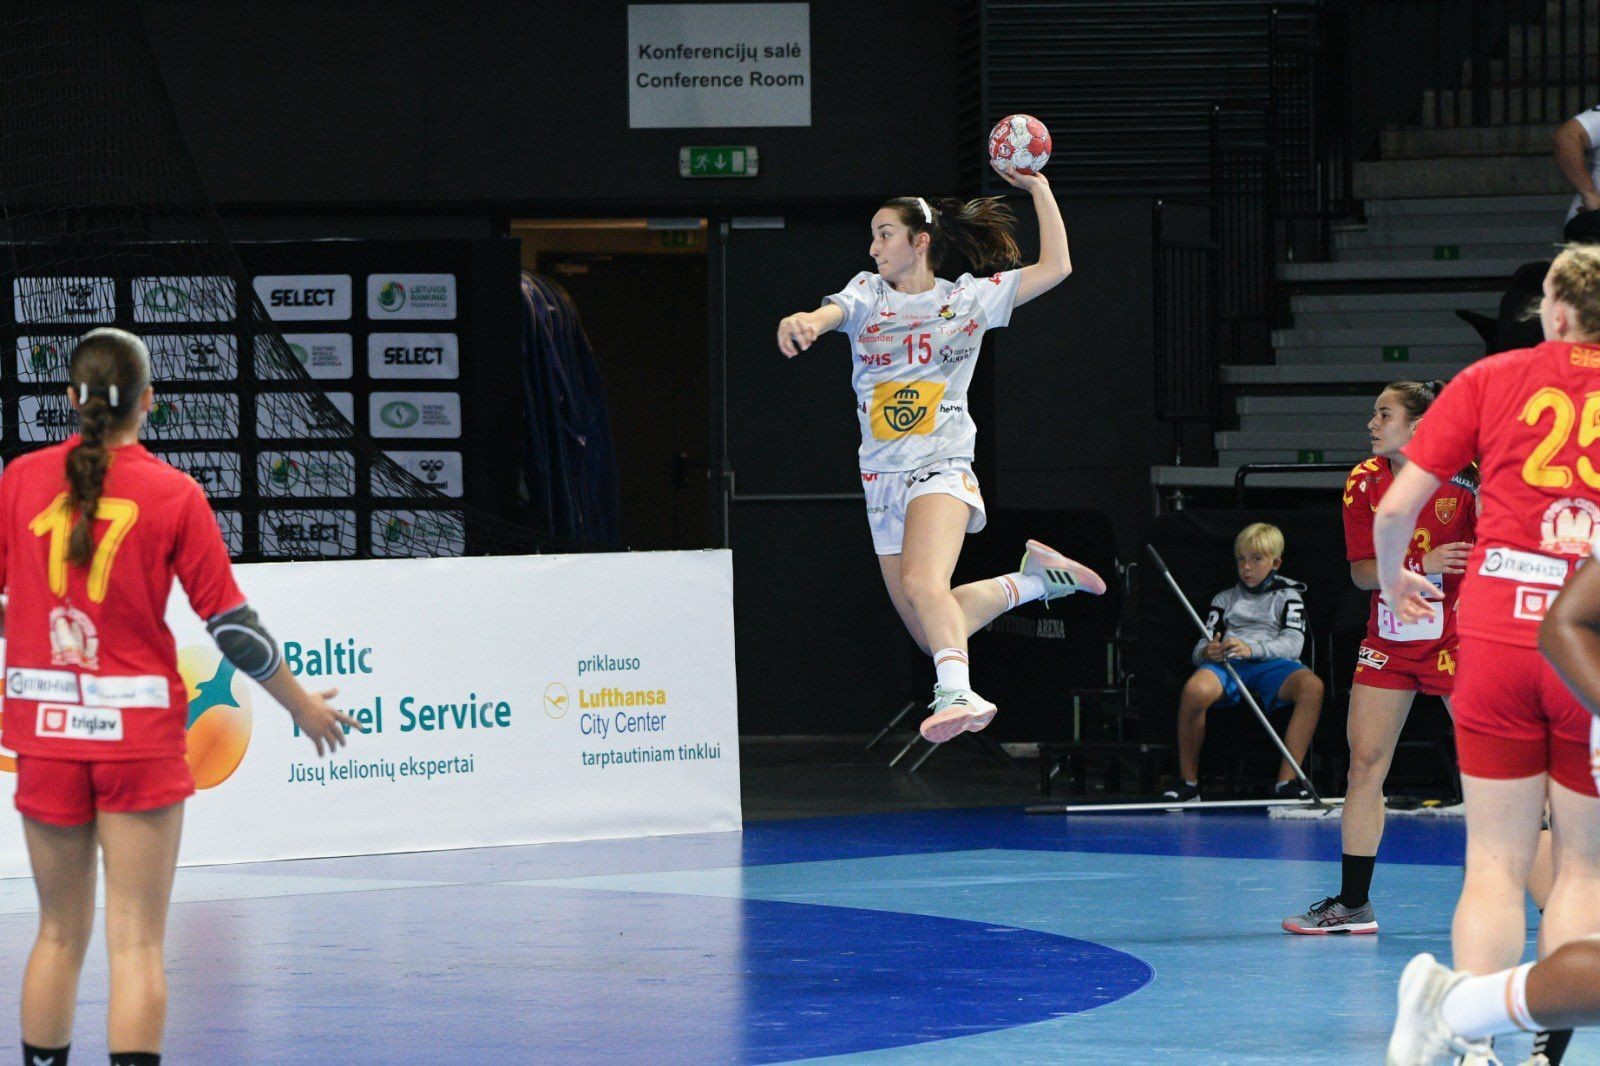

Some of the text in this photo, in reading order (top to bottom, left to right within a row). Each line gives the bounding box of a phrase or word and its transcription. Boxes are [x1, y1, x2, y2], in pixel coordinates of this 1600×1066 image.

[638, 43, 801, 62] Konferencijų salė
[636, 71, 804, 88] Conference Room
[270, 289, 335, 306] SELECT
[384, 347, 443, 365] SELECT
[902, 333, 932, 365] 15
[28, 491, 139, 604] 17
[1037, 618, 1066, 639] ARENA
[284, 638, 373, 676] Baltic
[578, 654, 640, 676] priklauso
[579, 688, 667, 708] Lufthansa
[399, 692, 512, 732] Service
[72, 715, 117, 734] triglav
[580, 711, 666, 739] City Center
[582, 742, 721, 769] tarptautiniam tinklui
[288, 754, 474, 786] Jūsų kelionių ekspertai
